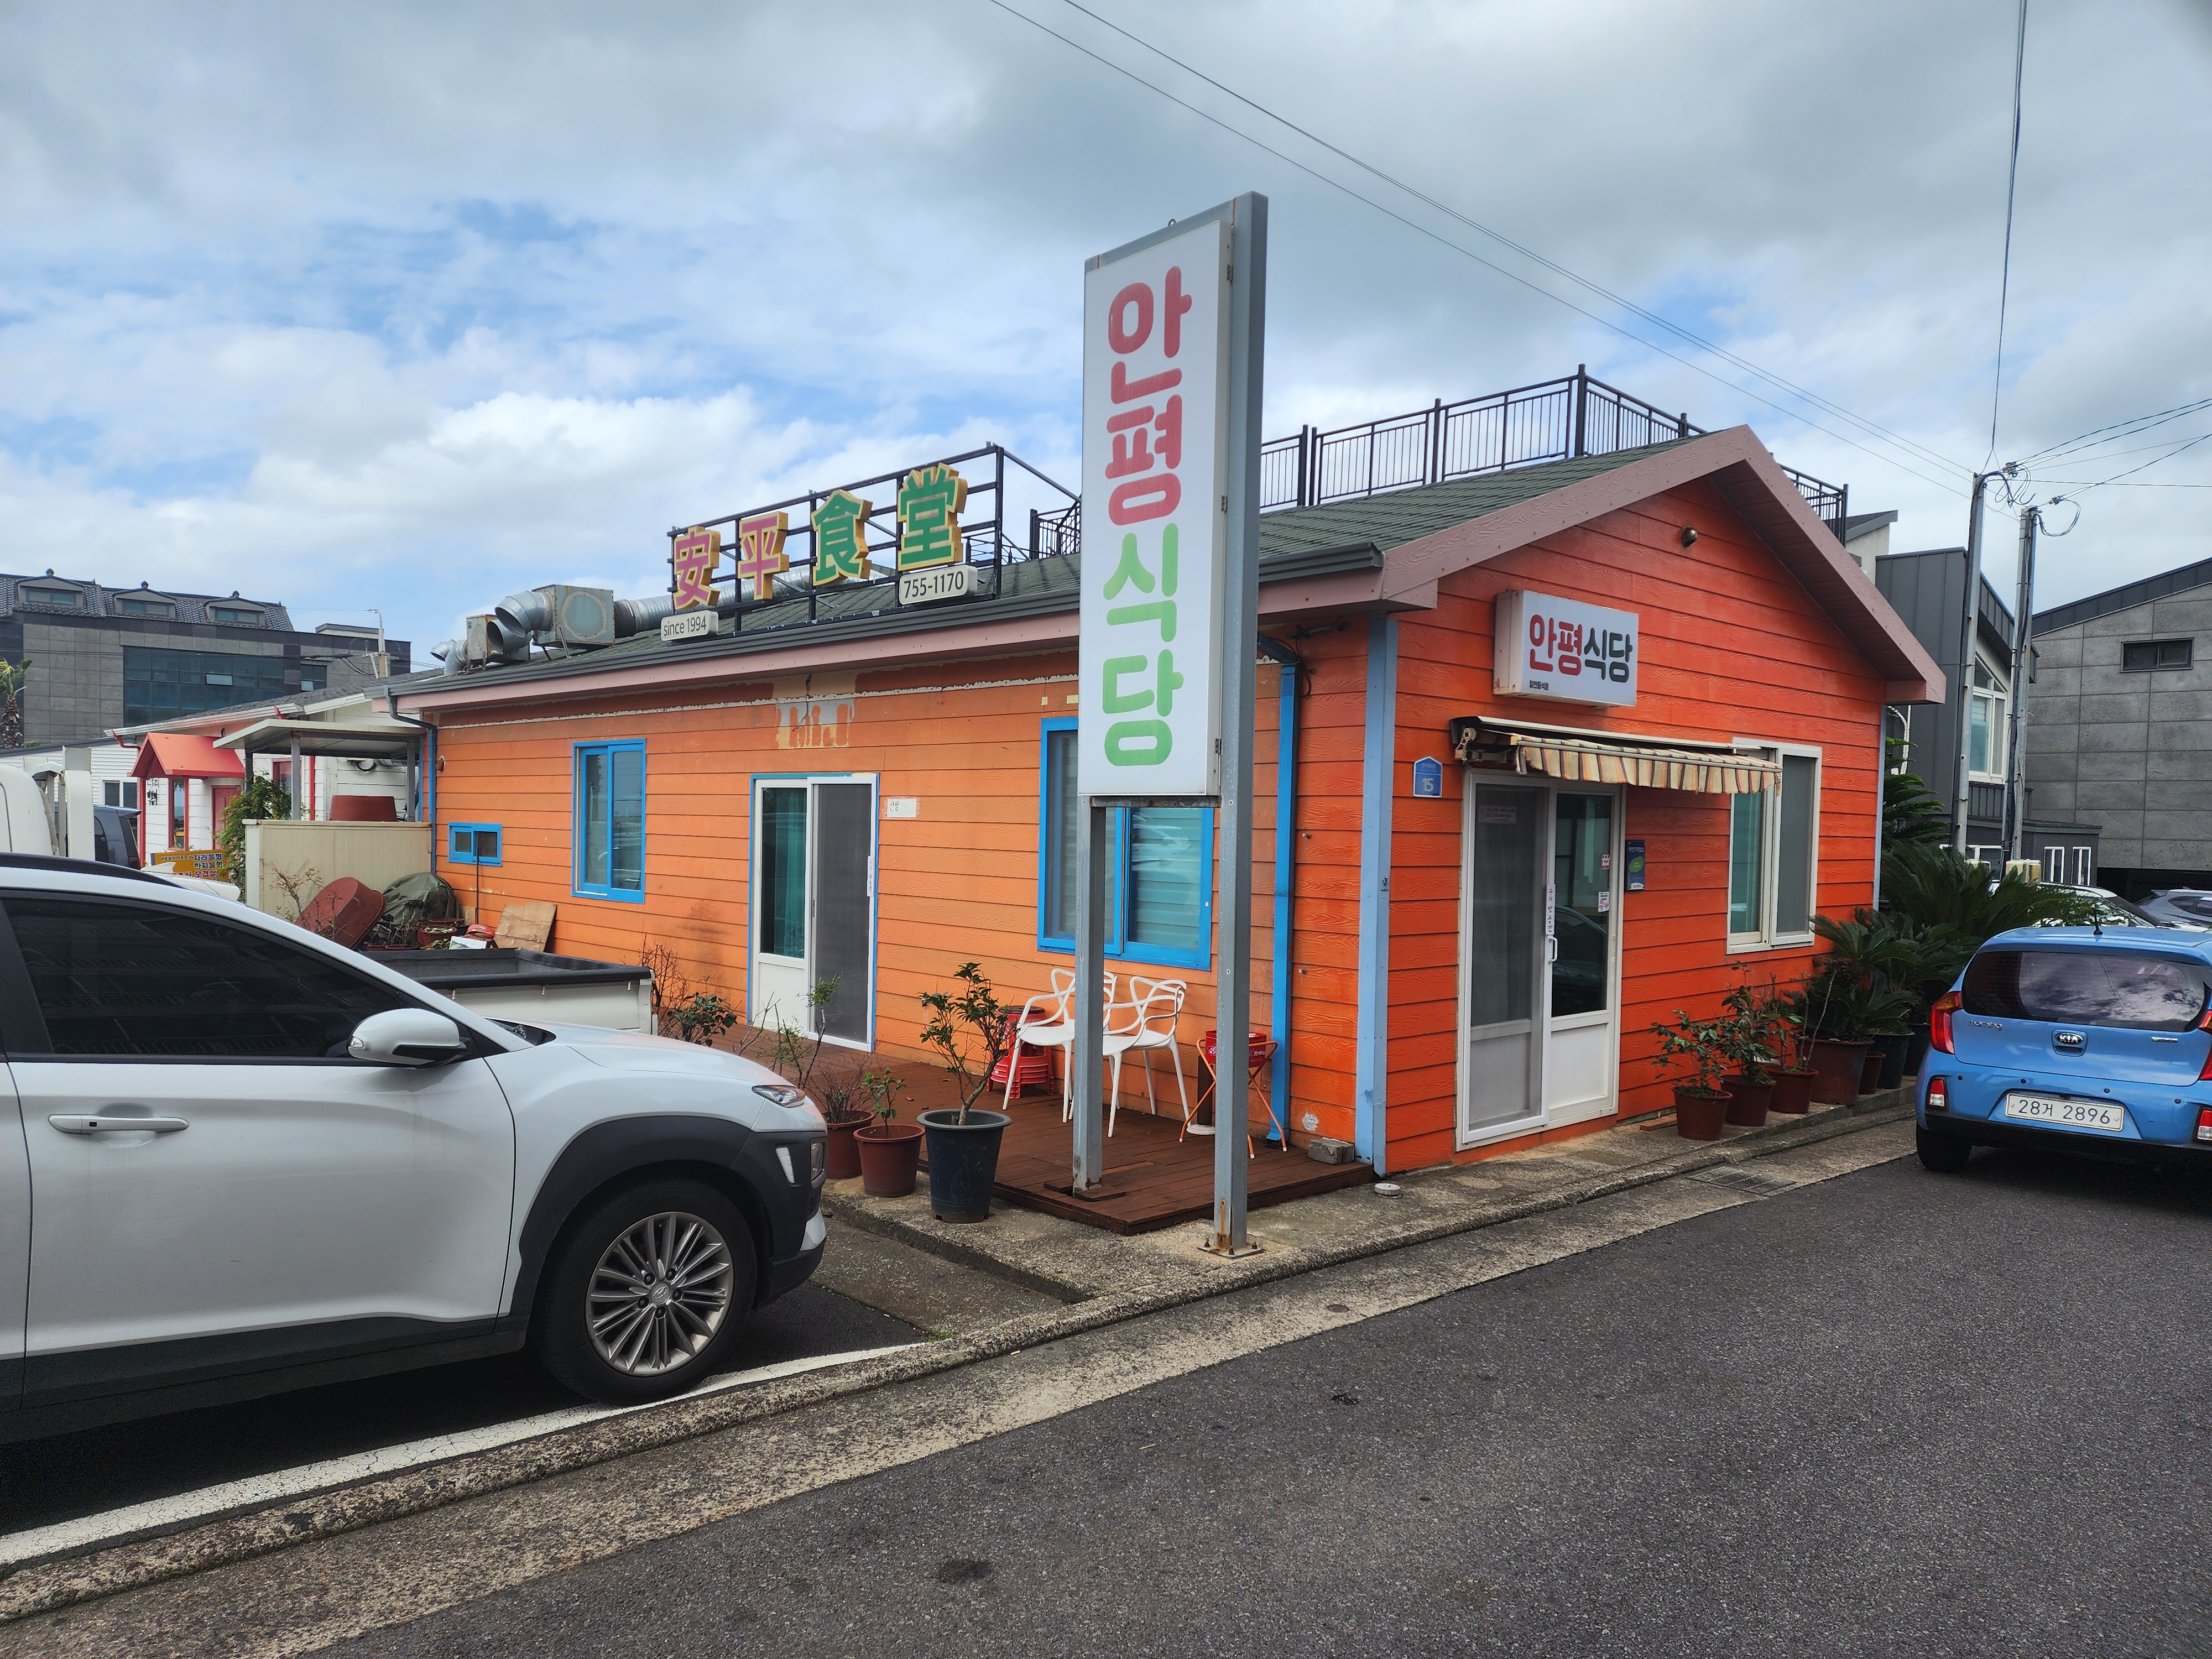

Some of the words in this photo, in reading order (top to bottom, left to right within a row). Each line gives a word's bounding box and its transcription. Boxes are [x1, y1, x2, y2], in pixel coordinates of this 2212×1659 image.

[1102, 265, 1192, 766] 안평식당
[673, 462, 967, 609] 安平食堂
[904, 571, 964, 599] 755-1170
[664, 620, 685, 637] since
[686, 614, 707, 633] 1994
[1529, 614, 1633, 684] 안평식당
[1529, 680, 1549, 691] 일반음식점
[1422, 778, 1434, 792] 15
[2059, 1035, 2079, 1044] KIA
[2018, 1099, 2053, 1117] 28거
[2063, 1105, 2110, 1125] 2896
